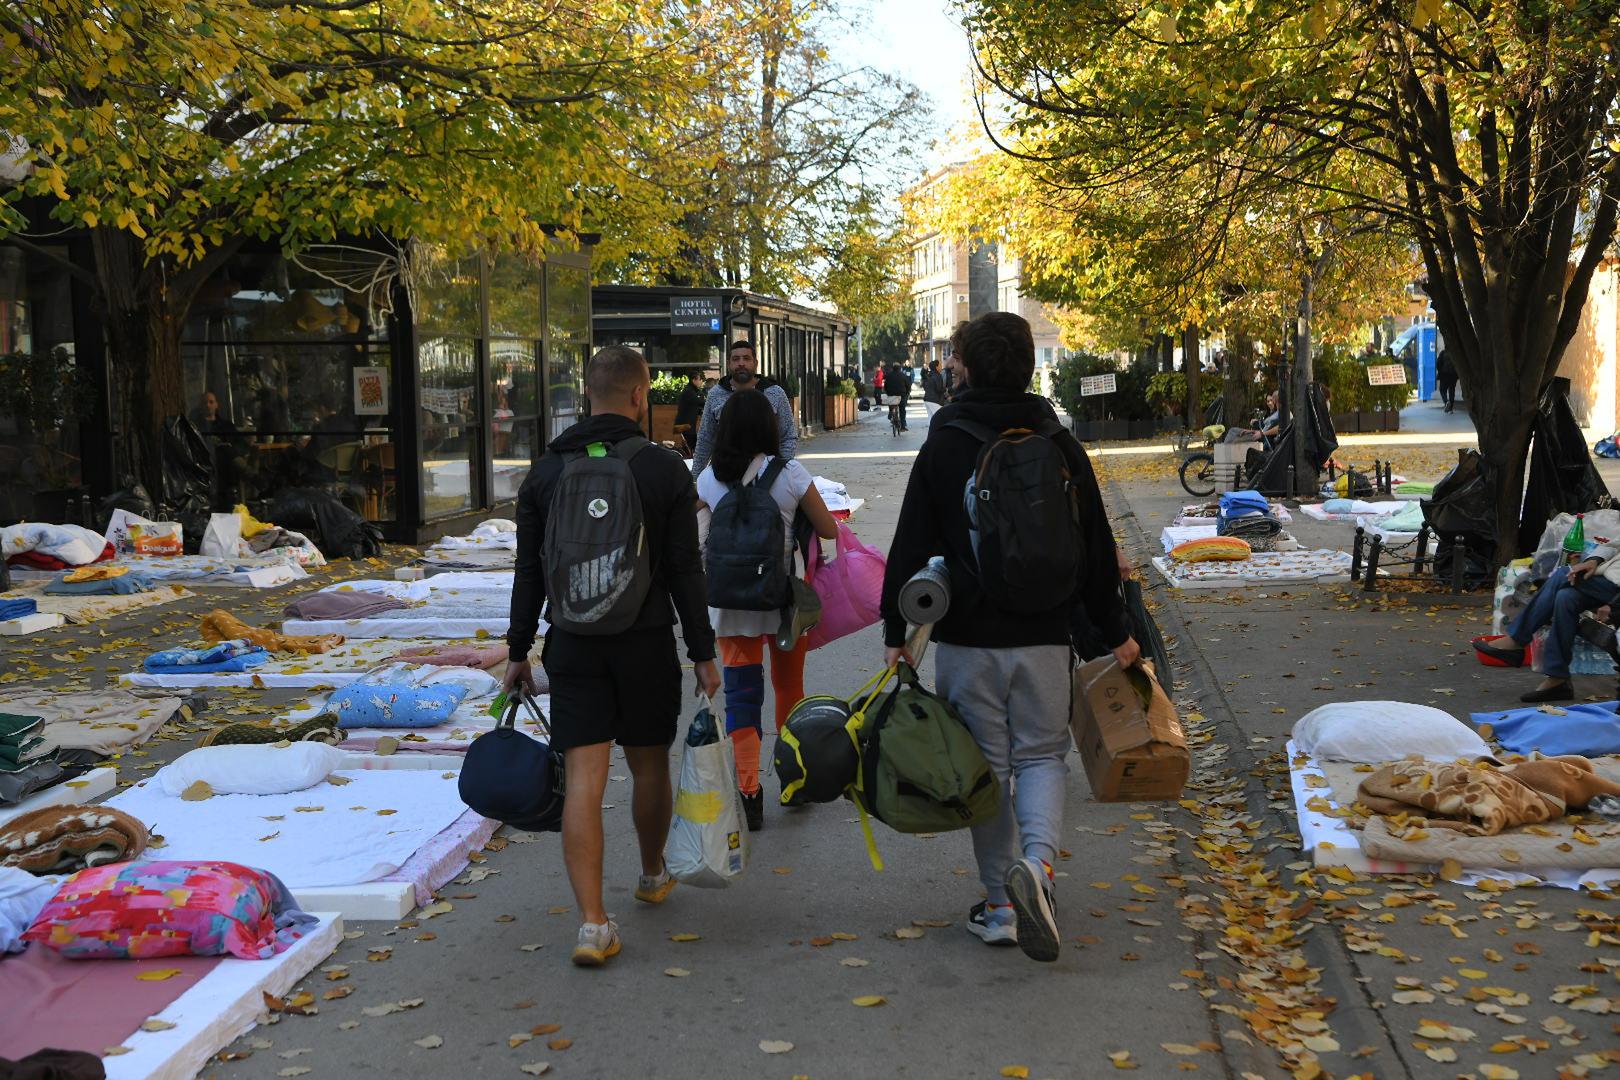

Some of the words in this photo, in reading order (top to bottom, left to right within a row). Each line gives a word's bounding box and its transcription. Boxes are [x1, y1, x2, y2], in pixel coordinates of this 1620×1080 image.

[681, 300, 713, 308] HOTEL
[674, 308, 720, 316] CENTRAL
[711, 318, 720, 330] P
[358, 375, 381, 388] PIZZA
[361, 397, 384, 409] PARTY
[142, 545, 177, 553] Desigual
